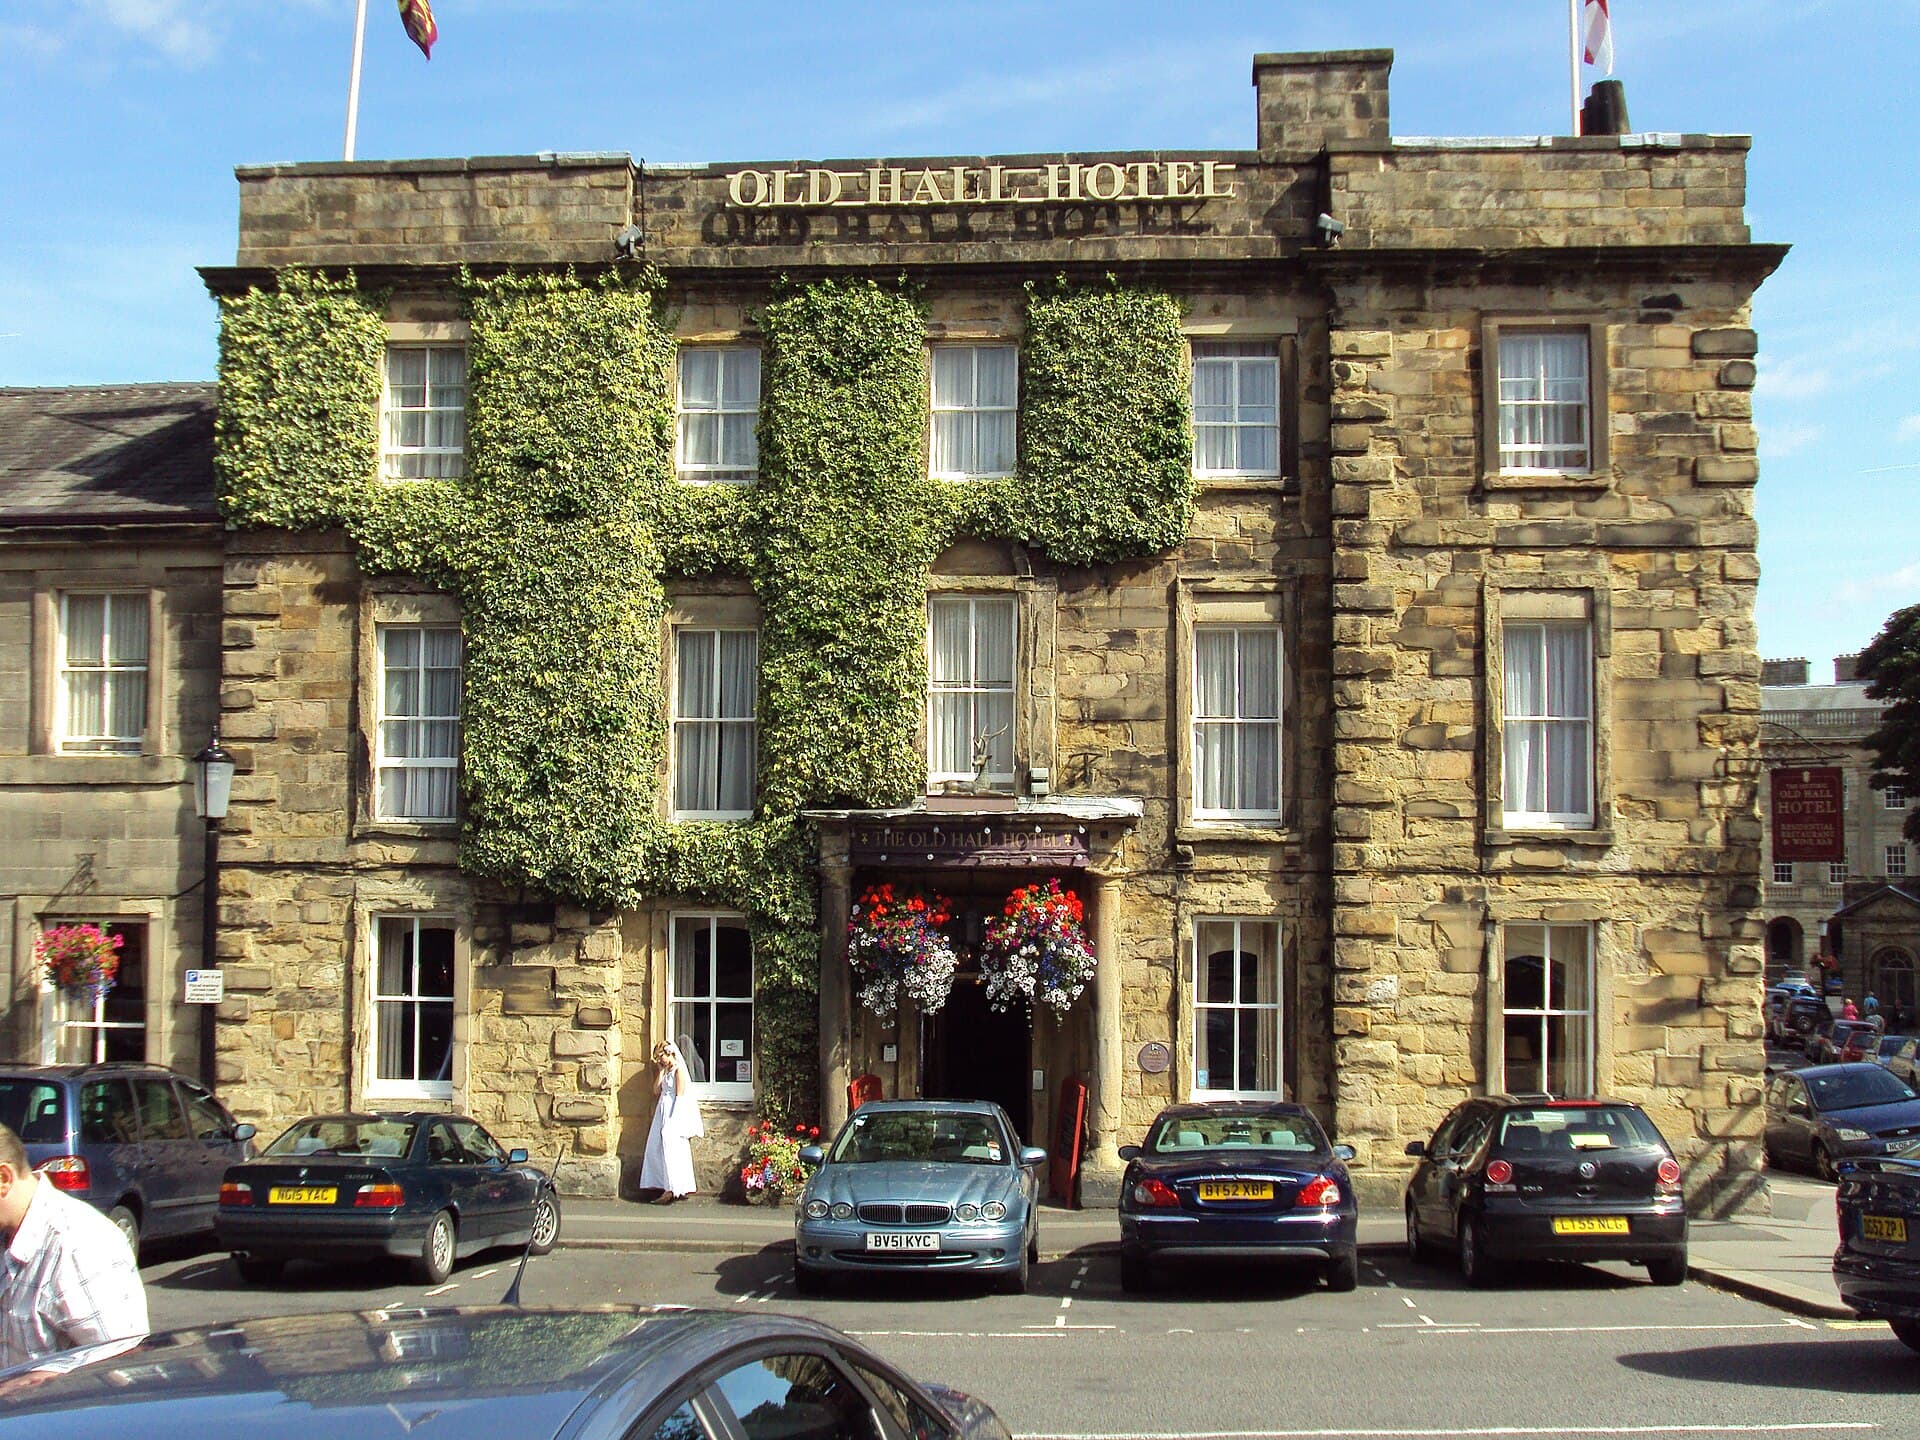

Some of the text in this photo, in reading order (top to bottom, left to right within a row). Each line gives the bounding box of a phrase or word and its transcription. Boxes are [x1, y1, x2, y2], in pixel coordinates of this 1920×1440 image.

[728, 161, 1235, 207] OLD HALL HOTEL
[1780, 789, 1833, 798] OLD HALL
[1777, 801, 1837, 814] HOTEL
[873, 831, 1062, 848] THE OLD HALL HOTEL
[1205, 1185, 1240, 1197] BT52
[906, 1235, 931, 1248] KYC
